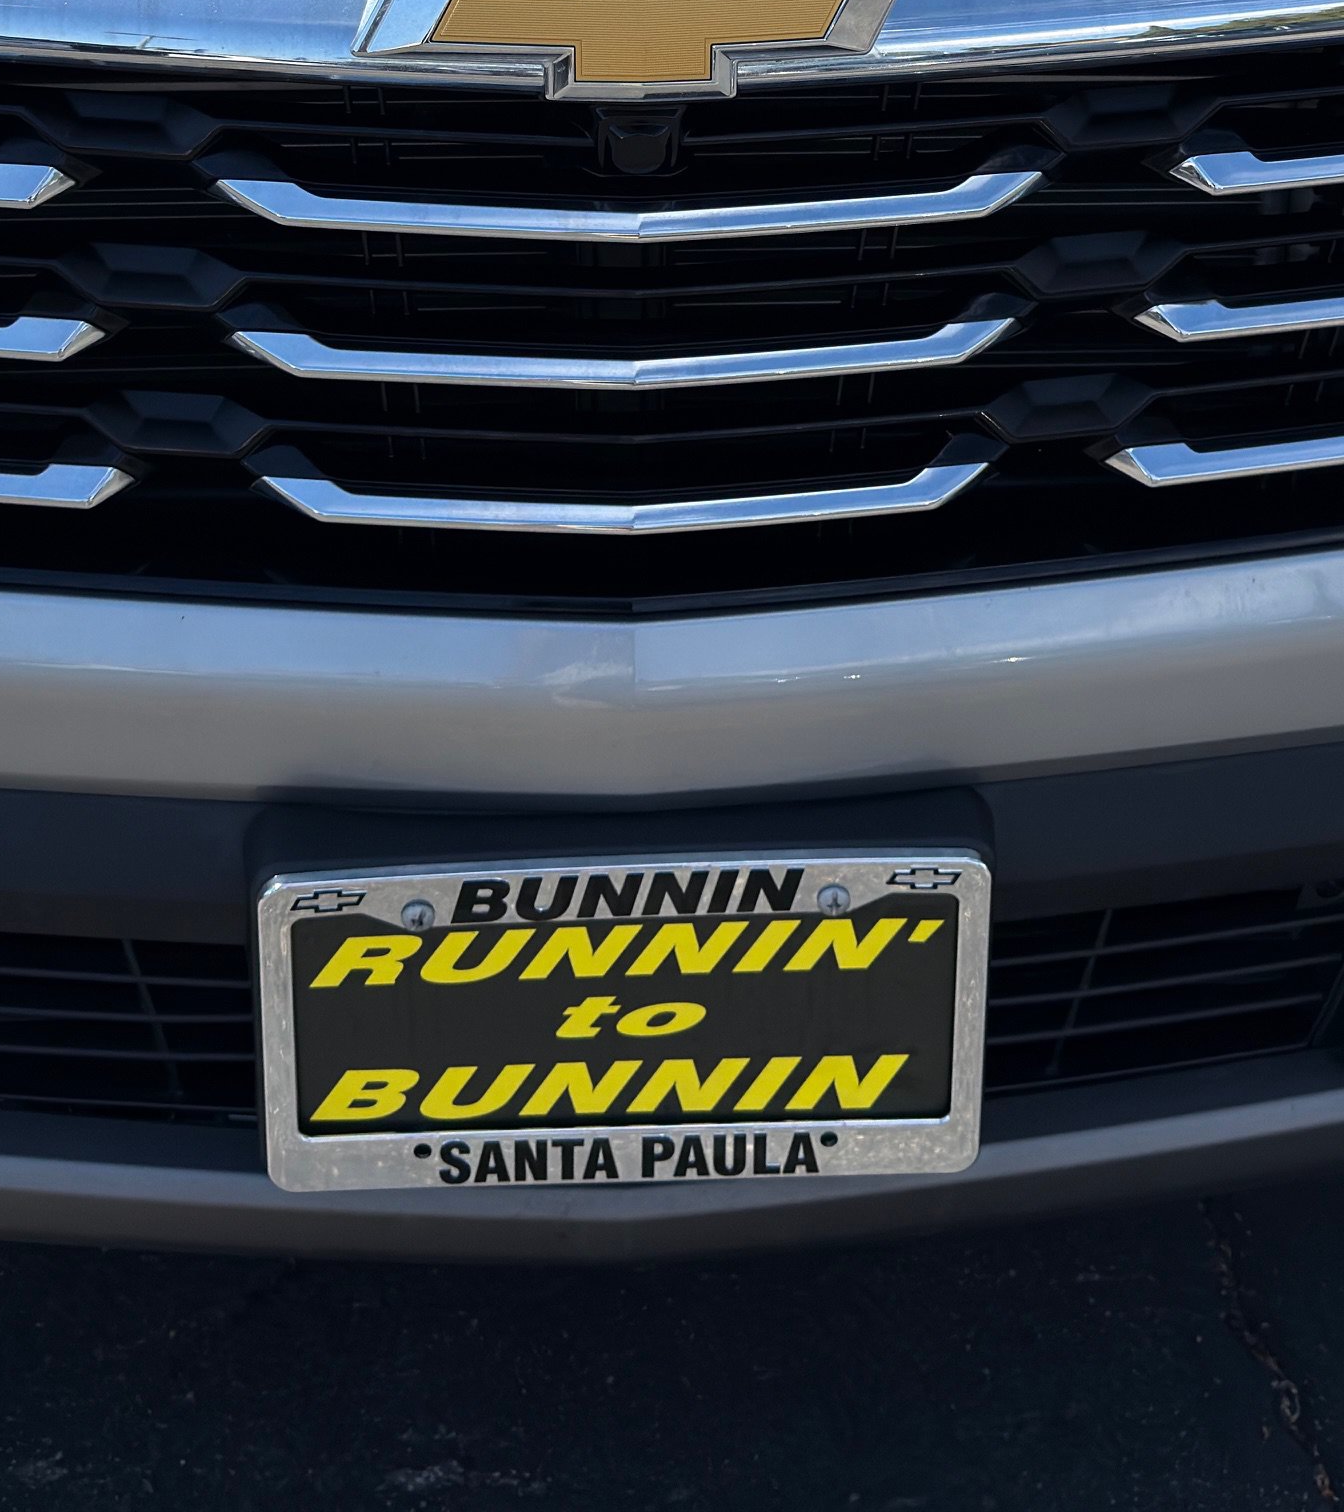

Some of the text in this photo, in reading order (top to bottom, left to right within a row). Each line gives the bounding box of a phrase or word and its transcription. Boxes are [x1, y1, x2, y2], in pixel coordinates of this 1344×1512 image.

[450, 867, 806, 923] BUNNIN
[308, 918, 946, 988] RUNNIN'
[555, 995, 708, 1039] to
[308, 1053, 911, 1122] BUNNIN
[438, 1131, 820, 1185] SANTA PAULA
